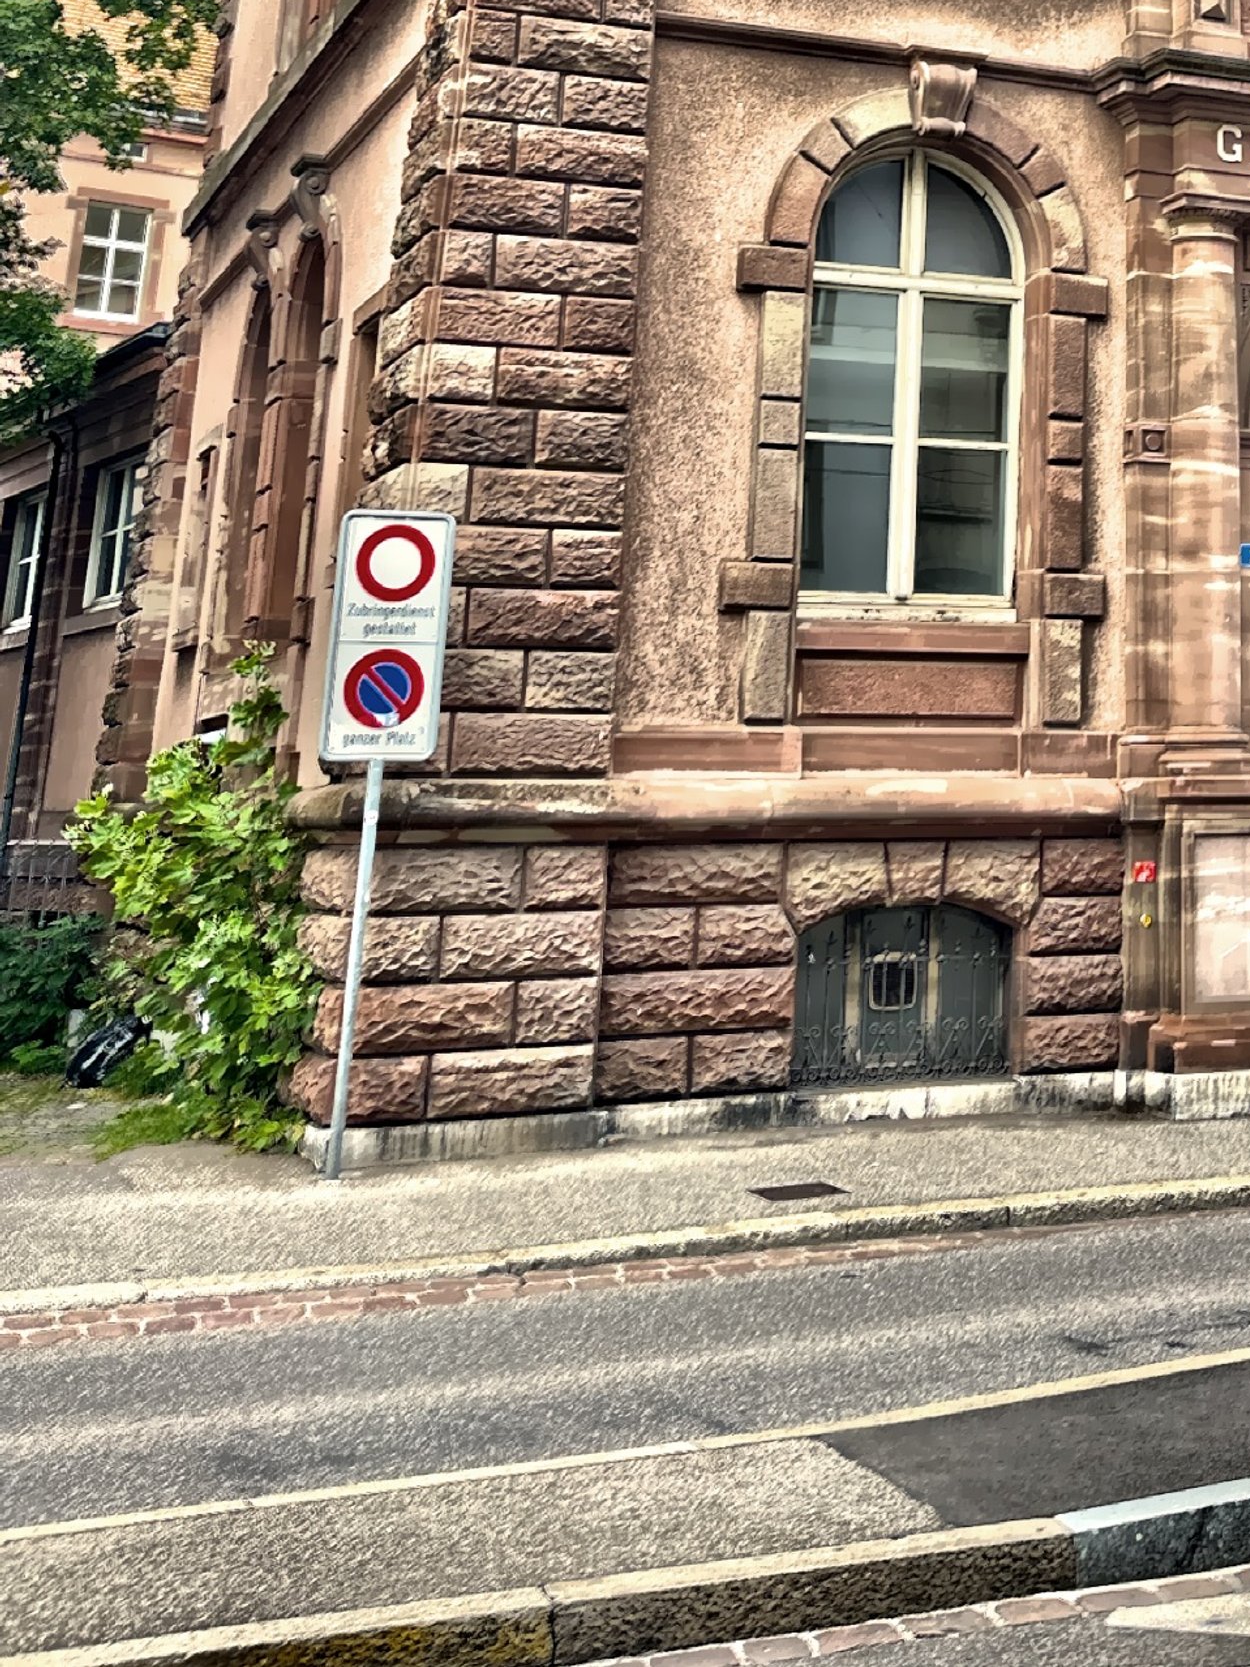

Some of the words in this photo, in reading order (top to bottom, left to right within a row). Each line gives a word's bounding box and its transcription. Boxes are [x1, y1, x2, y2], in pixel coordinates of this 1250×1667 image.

[347, 603, 435, 620] Zubringerdienst
[363, 622, 416, 638] gestattet
[343, 734, 381, 748] ganzer
[385, 731, 416, 745] Platz
